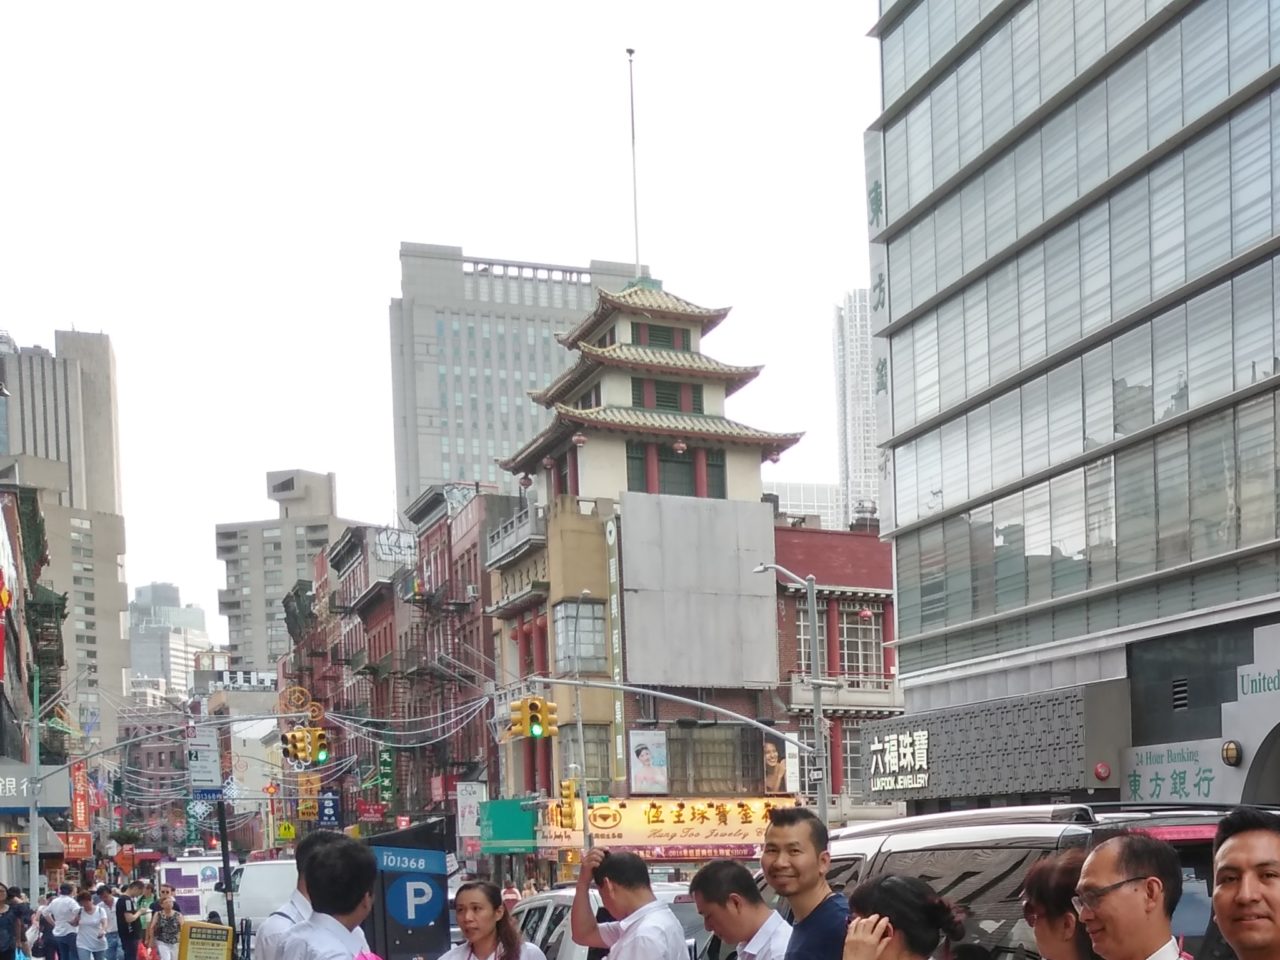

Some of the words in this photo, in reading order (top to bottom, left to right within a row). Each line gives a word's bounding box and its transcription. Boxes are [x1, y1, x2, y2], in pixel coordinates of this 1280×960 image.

[1240, 669, 1280, 696] United
[870, 730, 928, 775] 六福珠寶
[1145, 751, 1165, 766] Hour
[1167, 748, 1199, 766] Banking
[1127, 767, 1216, 801] 東方銀行
[704, 828, 749, 839] Jewelry
[383, 855, 426, 870] 101368
[406, 881, 433, 920] P
